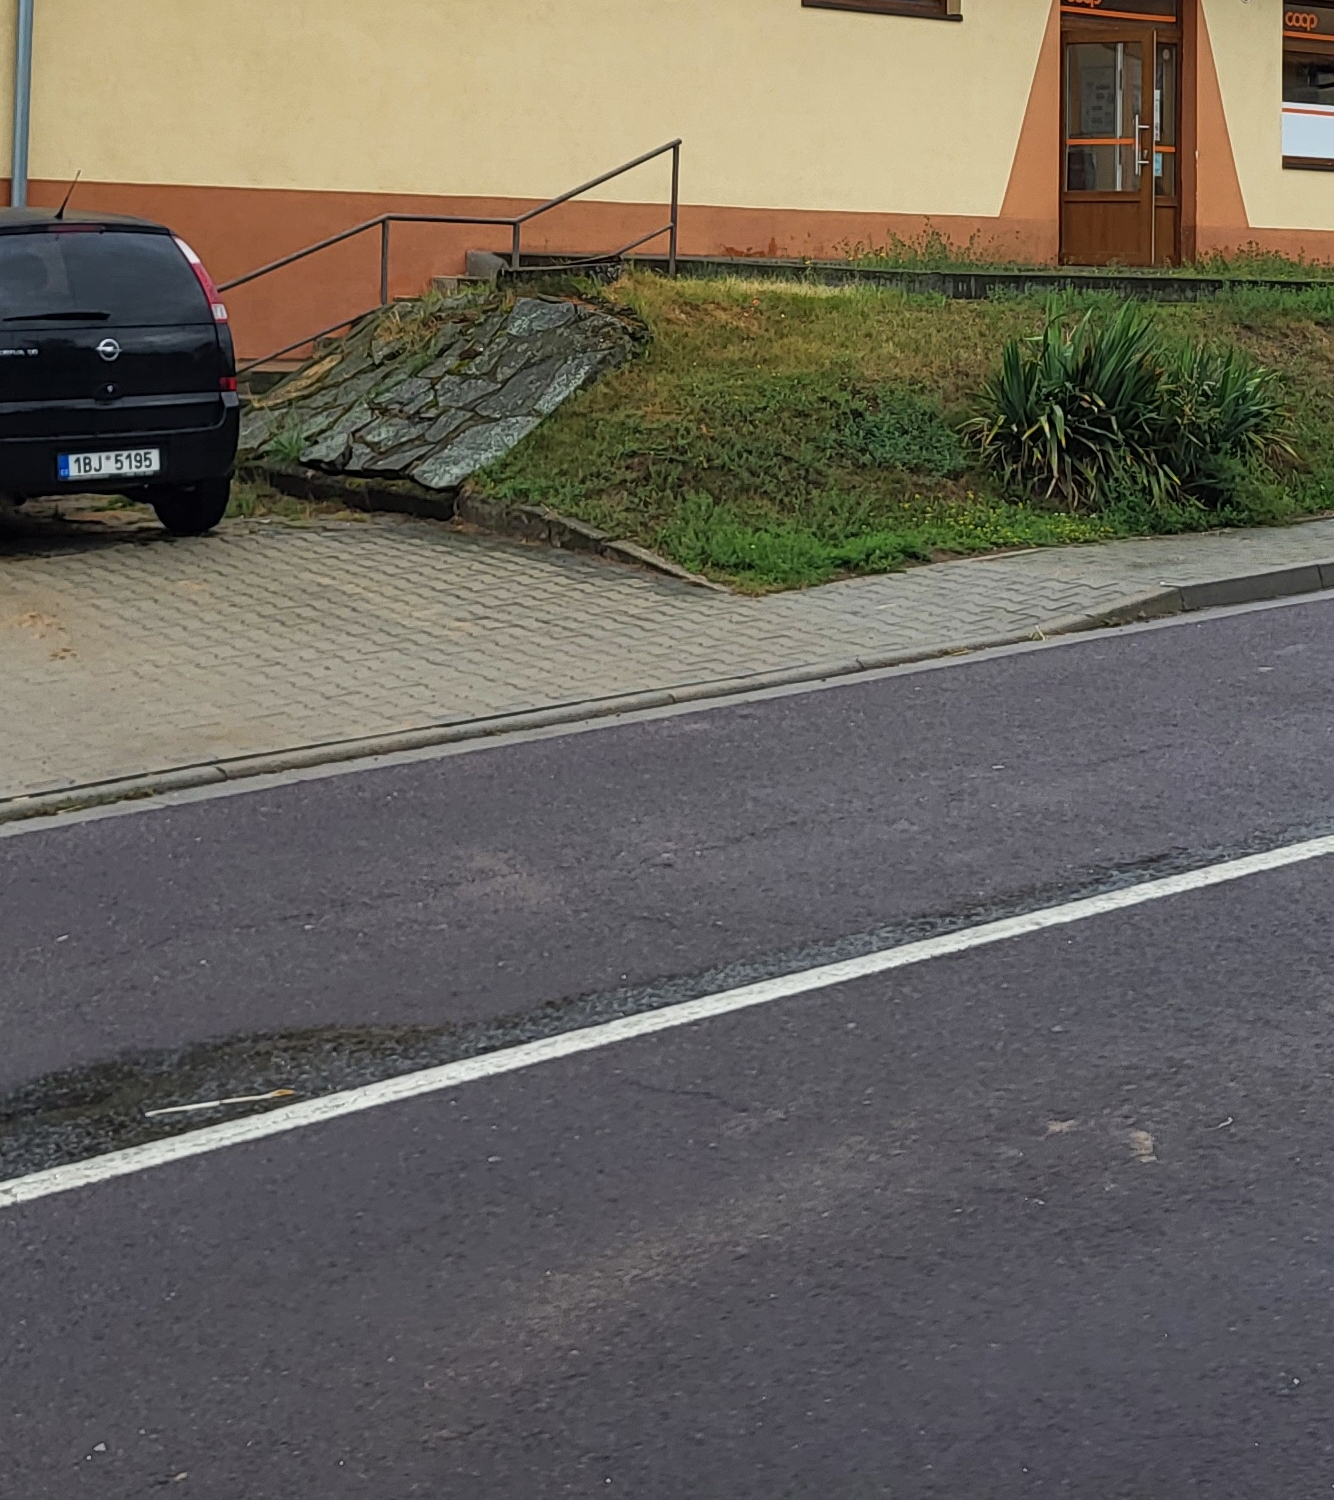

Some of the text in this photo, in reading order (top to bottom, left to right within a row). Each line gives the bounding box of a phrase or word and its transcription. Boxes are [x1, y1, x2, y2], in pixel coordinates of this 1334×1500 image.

[1285, 11, 1317, 31] coop
[74, 451, 152, 474] 1BJ 5195
